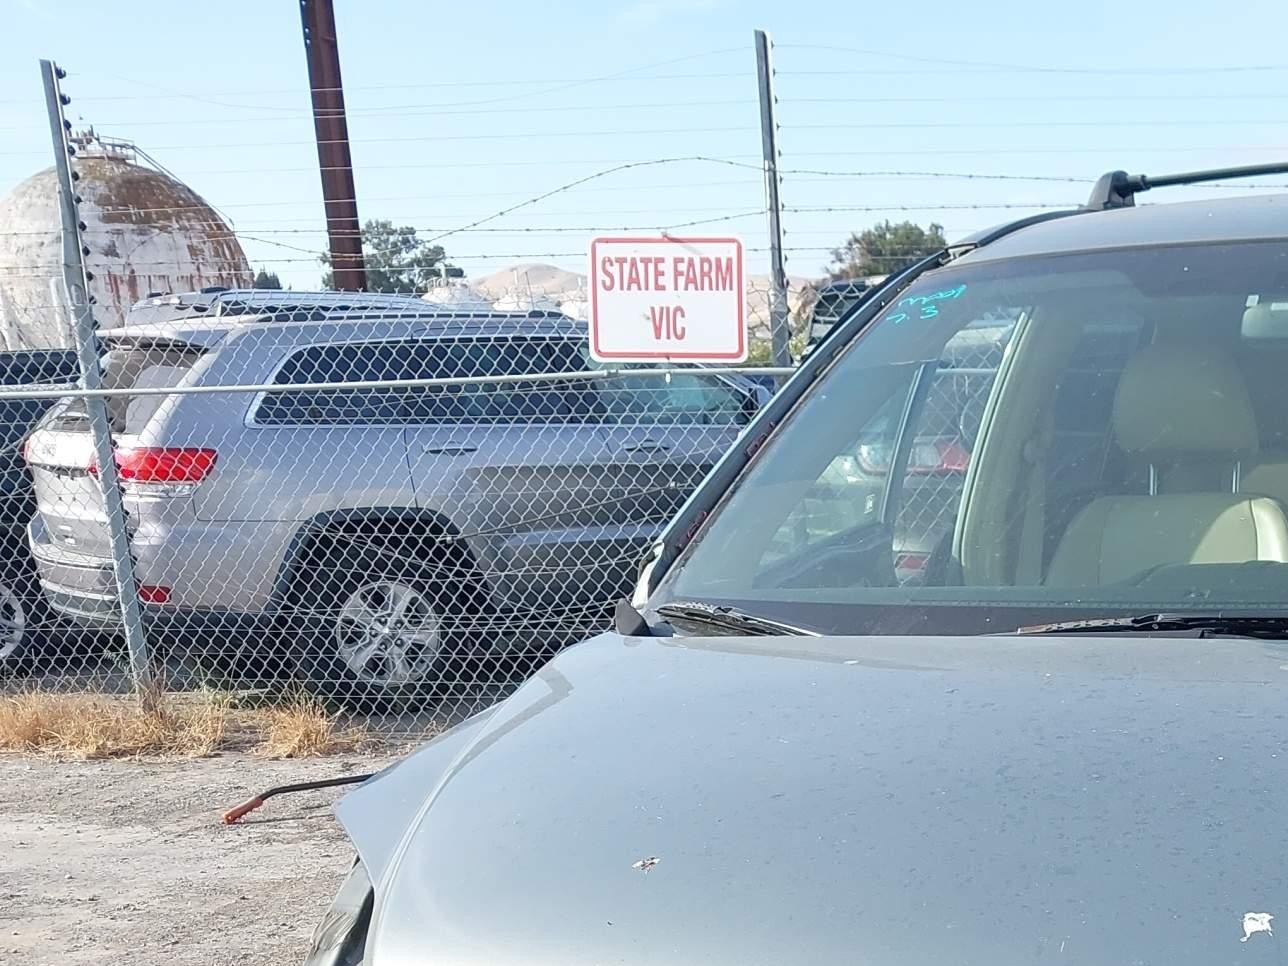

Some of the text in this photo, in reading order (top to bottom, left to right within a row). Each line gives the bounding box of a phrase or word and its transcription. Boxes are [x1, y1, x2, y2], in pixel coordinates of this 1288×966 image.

[601, 256, 733, 291] STATE FARM
[650, 305, 686, 340] VIC
